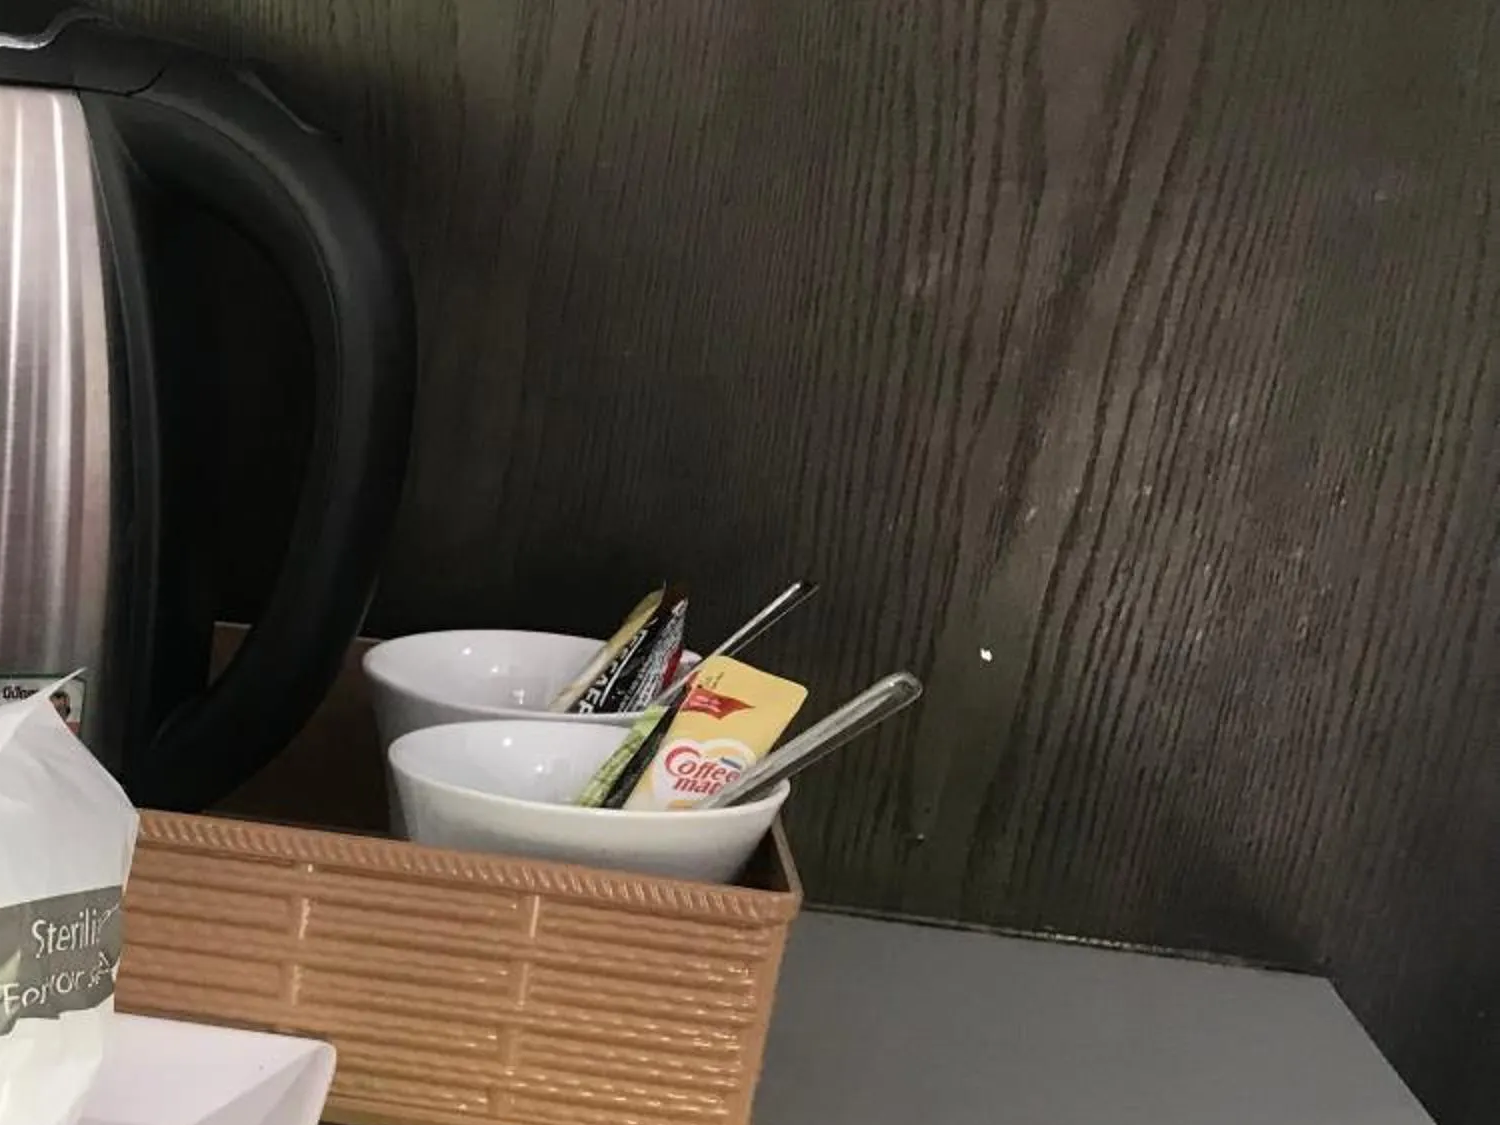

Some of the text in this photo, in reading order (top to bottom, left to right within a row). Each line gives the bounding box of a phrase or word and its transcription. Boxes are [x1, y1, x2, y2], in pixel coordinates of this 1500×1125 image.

[664, 747, 741, 782] Coffee
[673, 776, 724, 796] mat
[31, 907, 101, 959] Sterili
